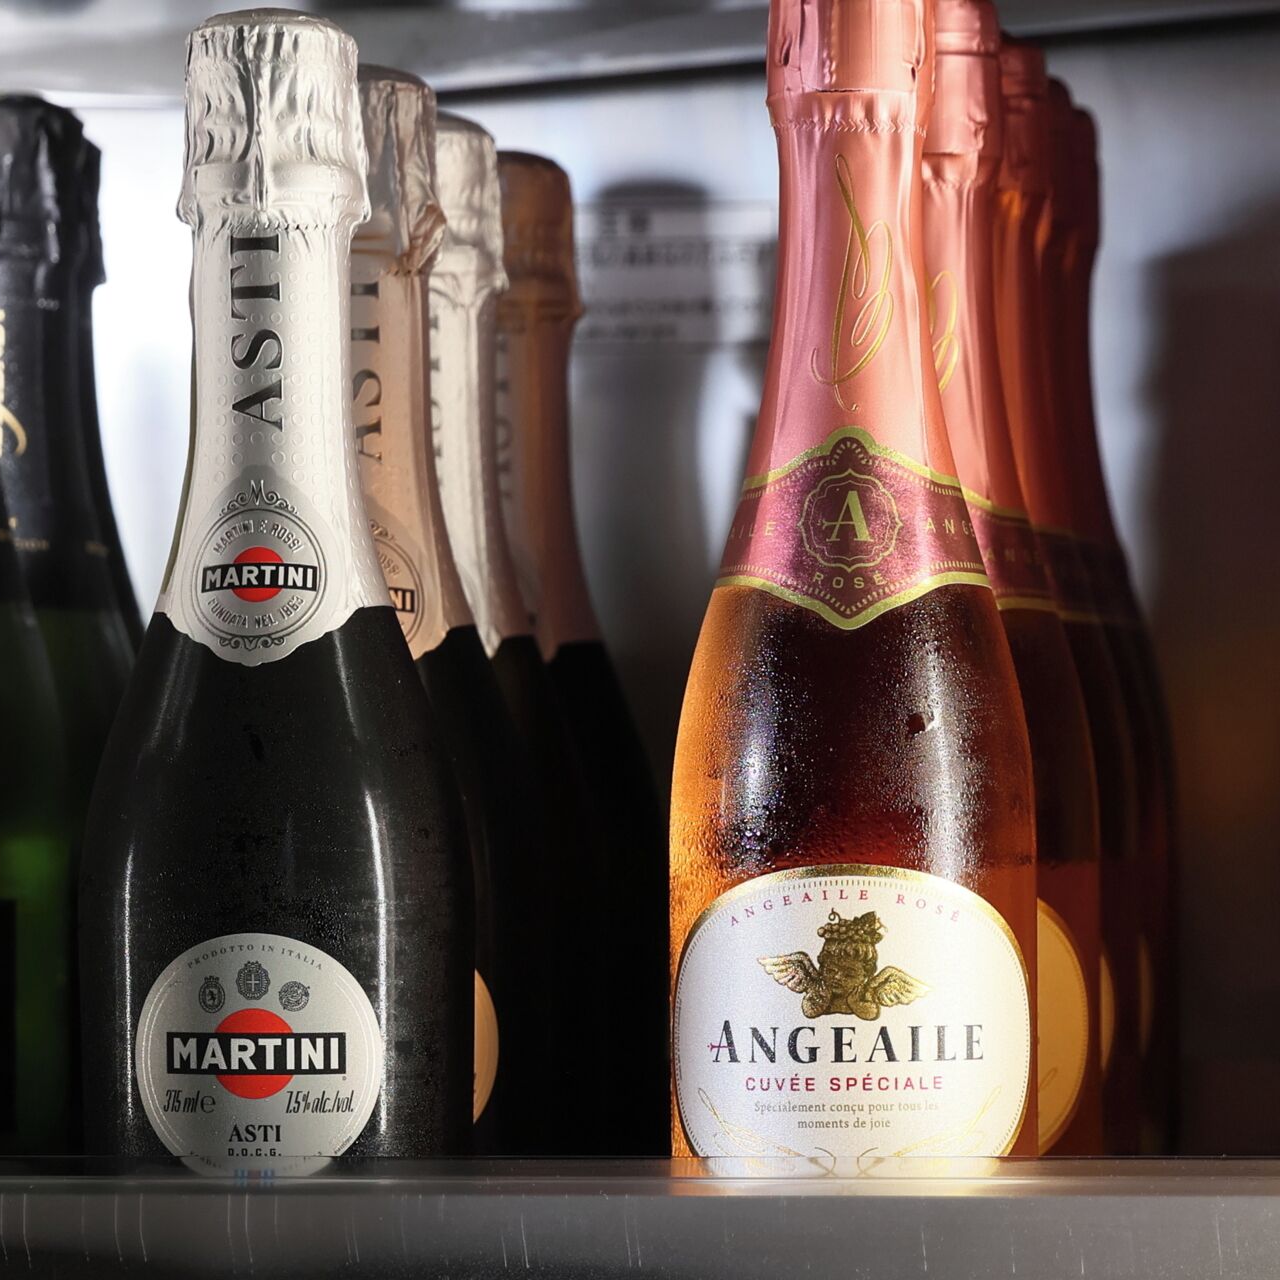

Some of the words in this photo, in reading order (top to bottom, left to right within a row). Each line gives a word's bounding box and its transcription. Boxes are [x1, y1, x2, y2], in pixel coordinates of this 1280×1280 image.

[229, 233, 284, 433] ASTI
[271, 523, 305, 554] ROSSI
[205, 564, 314, 590] MARTINI
[813, 570, 887, 589] ROSÉ
[730, 889, 869, 926] ANGEAILE
[896, 893, 960, 922] ROSÉ
[187, 943, 255, 970] PRODOTTO
[261, 944, 275, 953] IN
[282, 948, 323, 971] ITALIA
[172, 1036, 341, 1072] MARTINI
[707, 1019, 984, 1065] ANGEAILE
[745, 1074, 816, 1092] CUVÉE
[830, 1073, 944, 1092] SPÉCIALE
[868, 1102, 894, 1116] pour
[228, 1124, 282, 1143] ASTI
[797, 1118, 850, 1129] moments
[853, 1117, 867, 1129] de
[227, 1148, 282, 1157] D.O.C.G.
